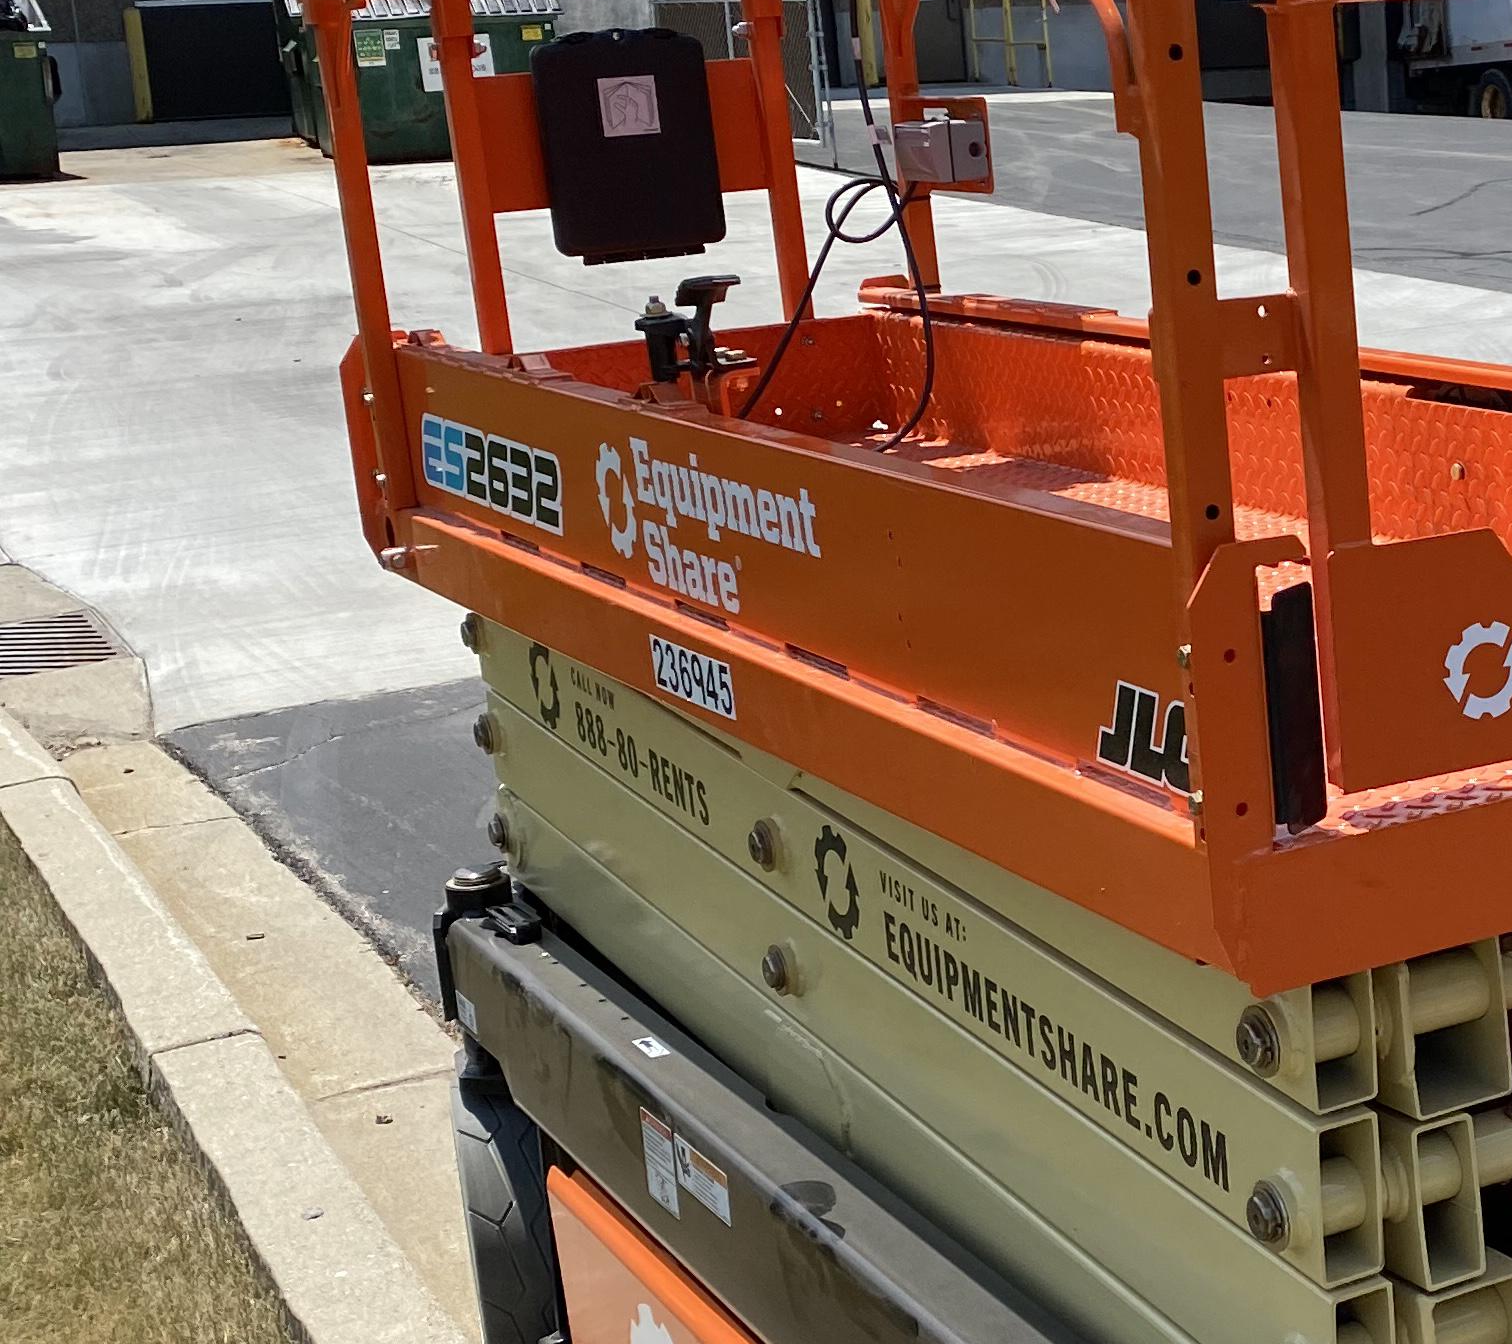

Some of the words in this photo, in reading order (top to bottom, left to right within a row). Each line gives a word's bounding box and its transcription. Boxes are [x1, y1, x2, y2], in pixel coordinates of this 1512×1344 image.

[421, 412, 563, 537] ES2632
[629, 436, 822, 558] Equipment
[642, 520, 741, 616] Share
[570, 666, 593, 696] CALL
[595, 681, 615, 711] NOW
[652, 637, 735, 716] 236945
[574, 701, 710, 826] 888-80-RENTS
[879, 869, 915, 913] VISIT
[921, 896, 939, 928] US
[945, 912, 967, 943] AT:
[883, 910, 1230, 1193] EQUIPMENTSHARE.COM
